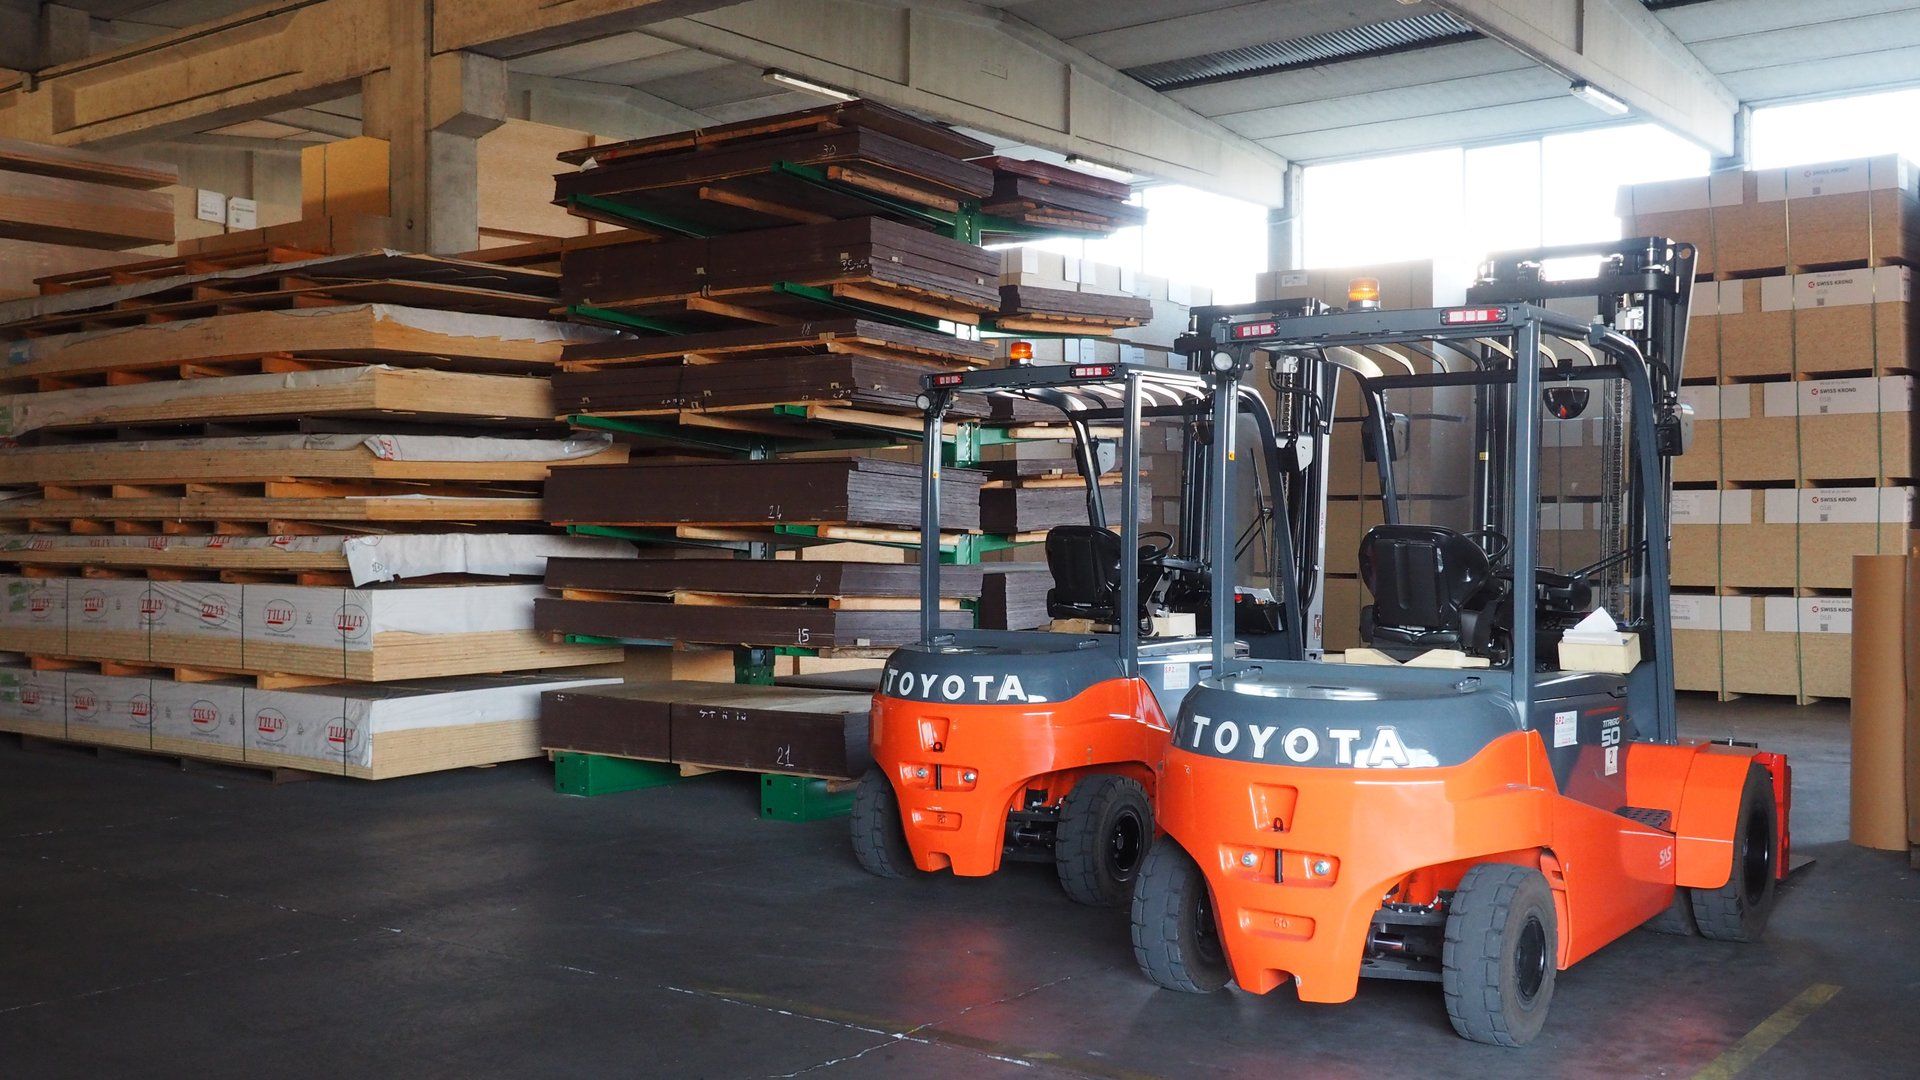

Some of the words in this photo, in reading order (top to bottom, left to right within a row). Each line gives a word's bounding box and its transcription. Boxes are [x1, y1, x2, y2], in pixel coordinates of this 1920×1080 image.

[823, 144, 837, 155] 30
[267, 608, 294, 622] TILLY
[337, 614, 364, 628] TILLY
[798, 628, 810, 644] 15
[887, 668, 1027, 701] TOYOTA
[193, 708, 217, 721] TILLY
[258, 715, 285, 730] TILLY
[328, 725, 356, 741] TILLY
[1193, 714, 1410, 767] TOYOTA
[1602, 725, 1621, 748] 50
[776, 743, 795, 767] 21
